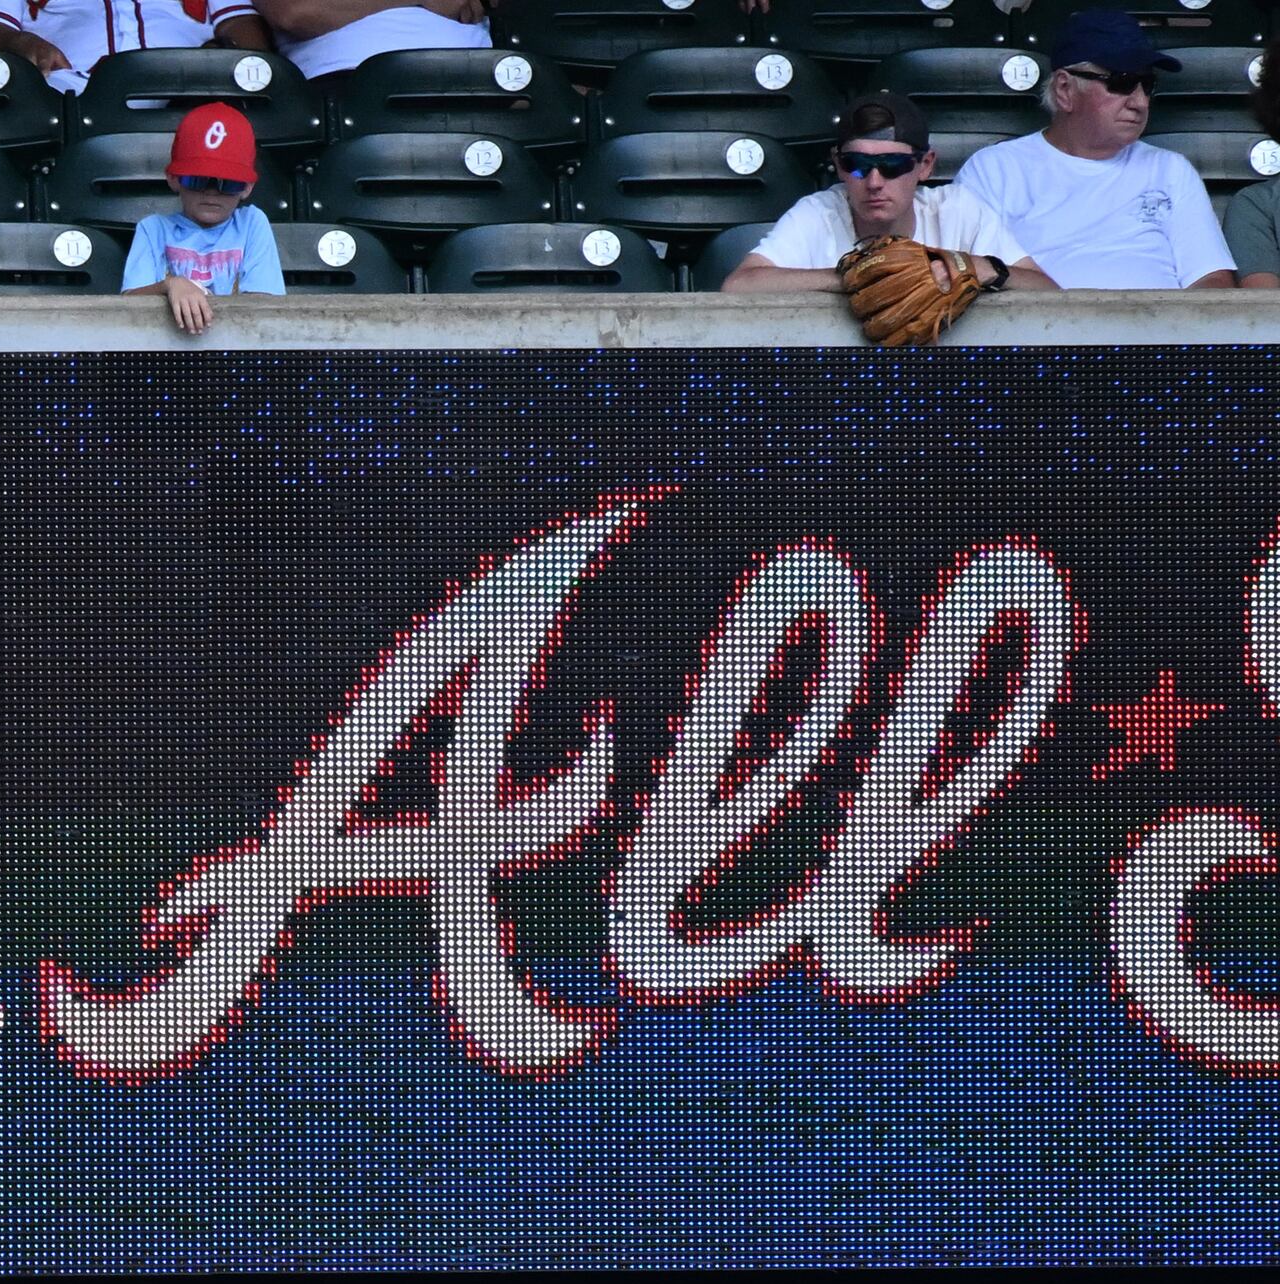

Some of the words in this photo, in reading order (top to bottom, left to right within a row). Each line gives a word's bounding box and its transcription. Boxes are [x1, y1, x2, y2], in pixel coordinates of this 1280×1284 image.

[247, 67, 260, 81] 11
[506, 66, 522, 81] 12
[767, 65, 782, 80] 13
[1014, 66, 1029, 80] 14
[204, 121, 228, 149] O
[476, 151, 491, 166] 12
[737, 150, 753, 164] 13
[1261, 151, 1278, 166] 15
[67, 241, 79, 255] 11
[330, 241, 345, 255] 12
[594, 241, 609, 255] 13
[38, 484, 989, 1084] All
